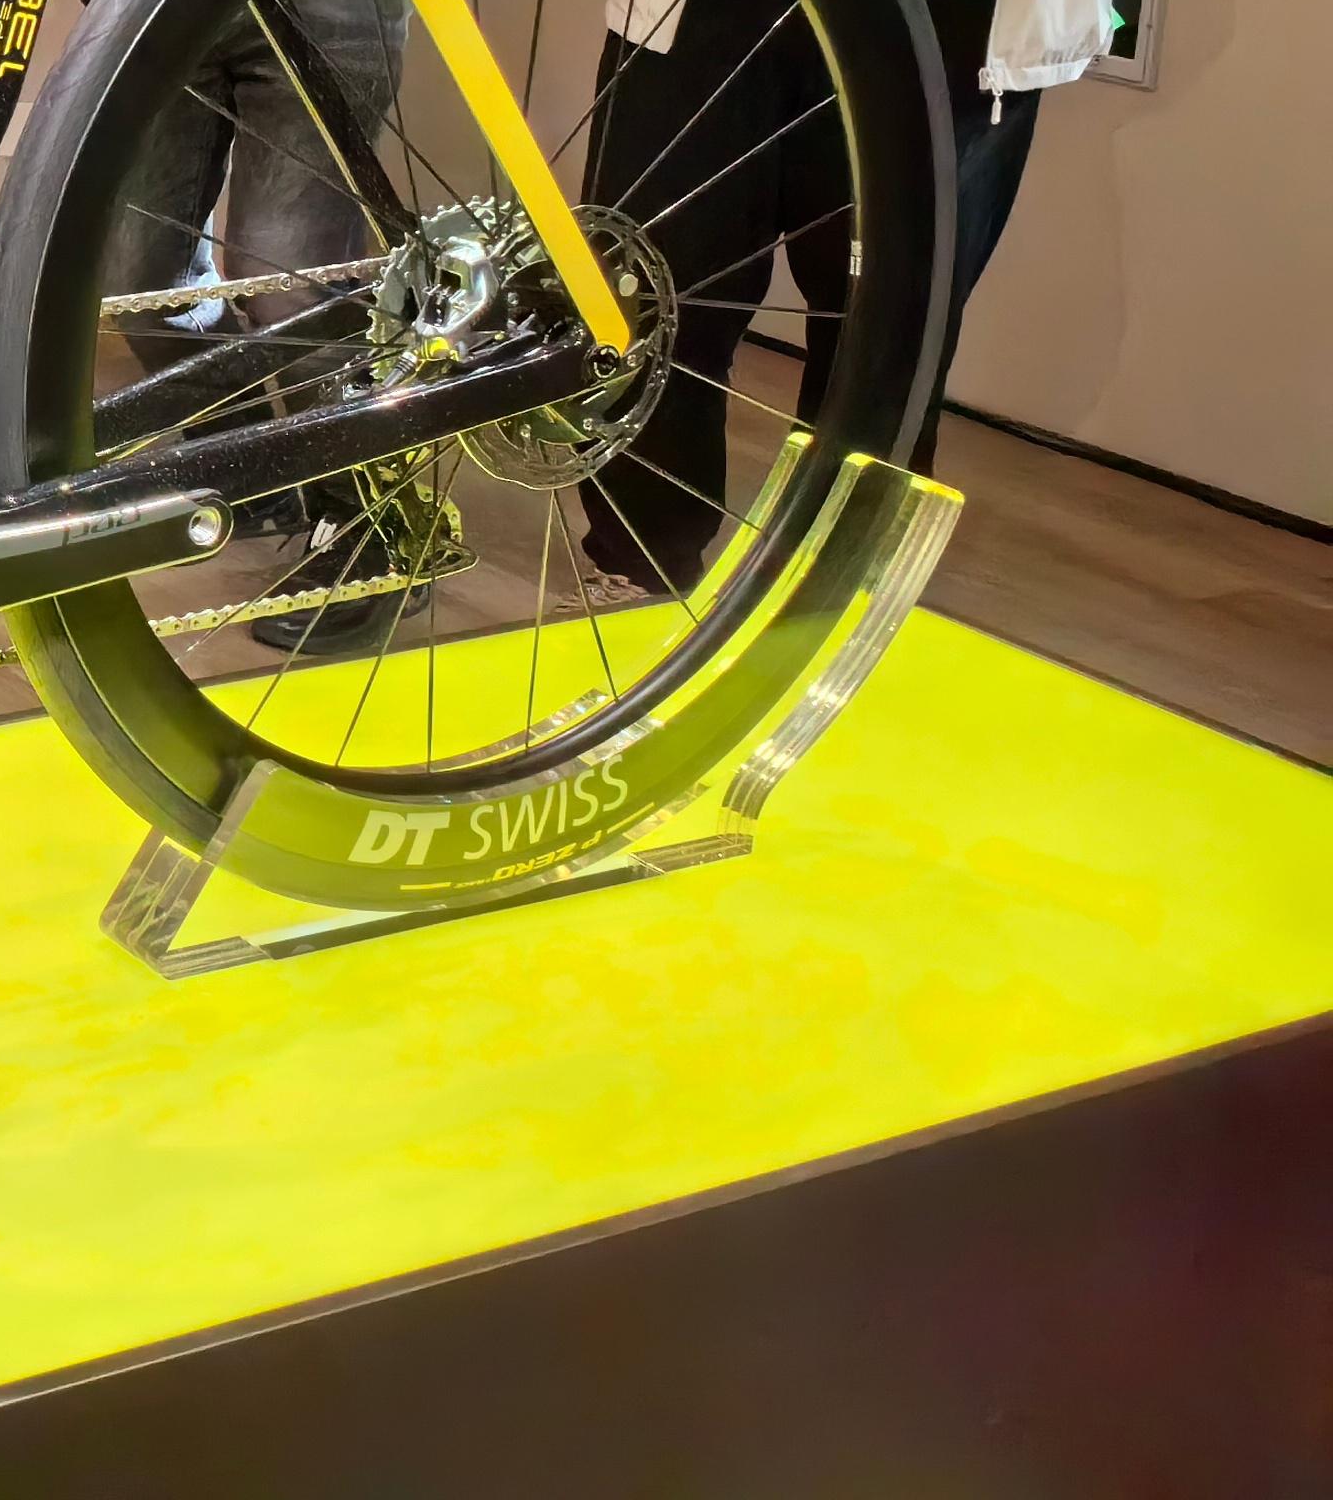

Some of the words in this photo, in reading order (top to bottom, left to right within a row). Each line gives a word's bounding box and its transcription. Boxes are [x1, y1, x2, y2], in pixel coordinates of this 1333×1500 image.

[347, 810, 450, 866] DT
[463, 753, 630, 861] SWISS
[491, 840, 578, 883] ZERO
[580, 829, 604, 852] P
